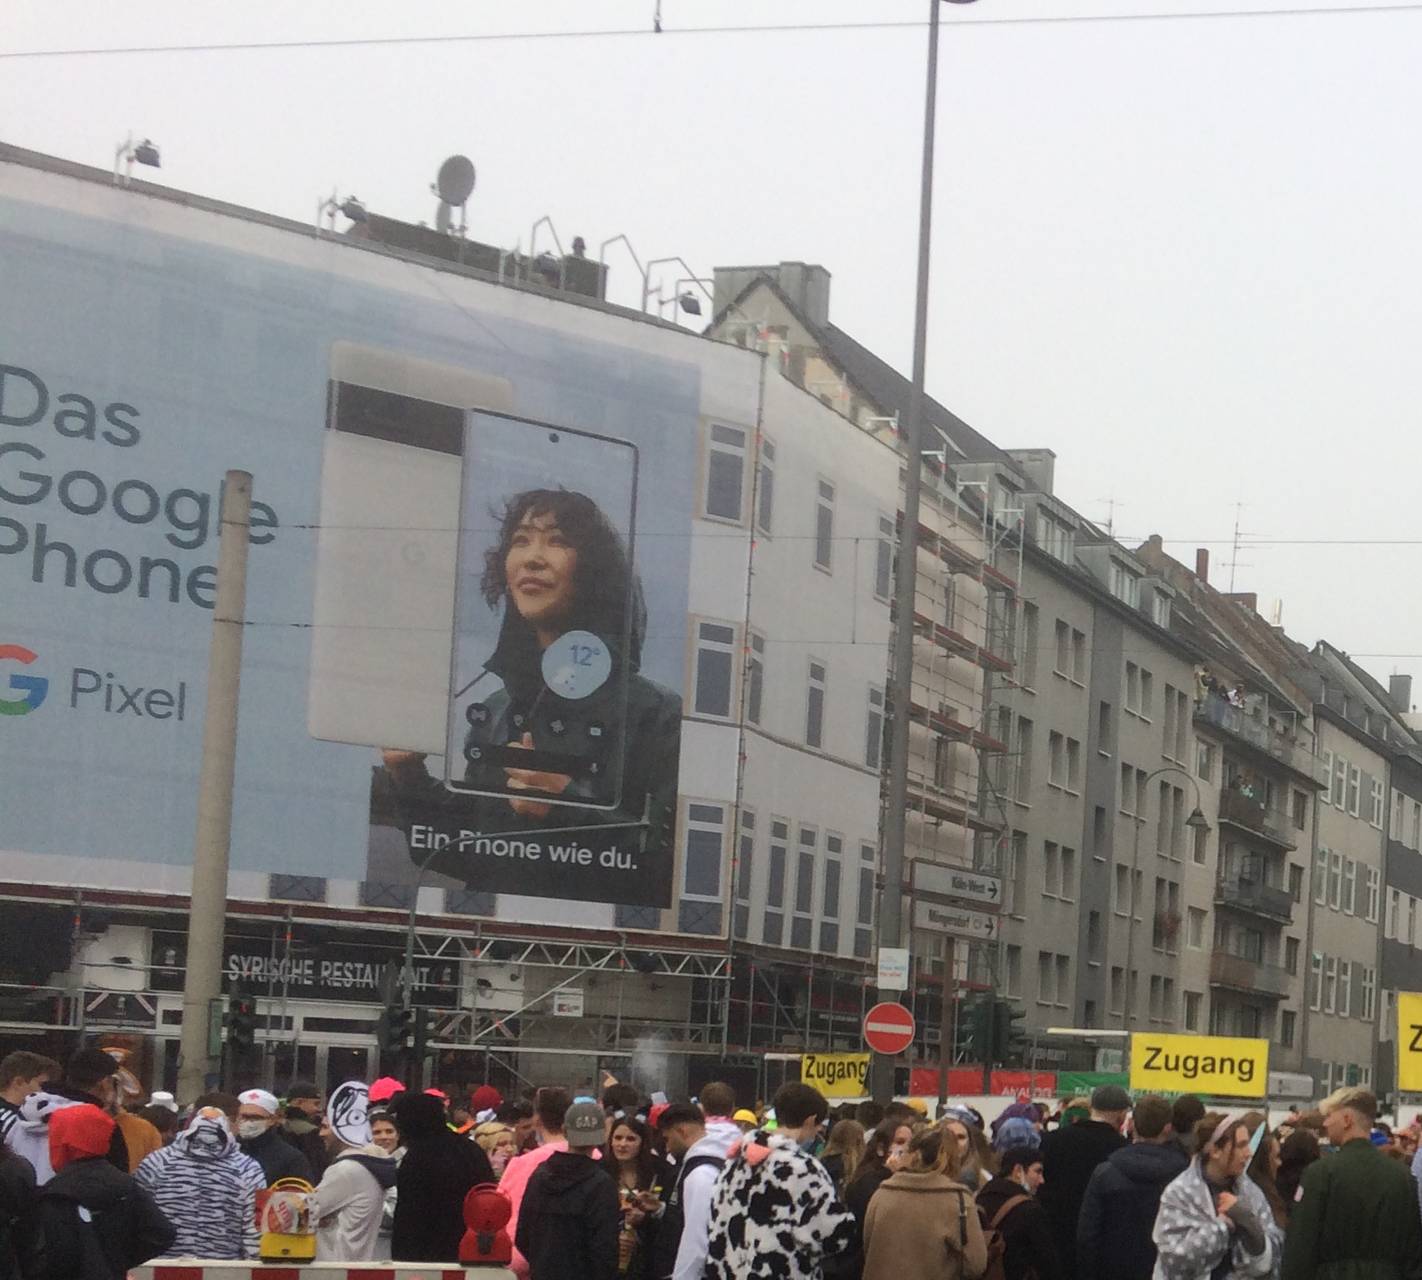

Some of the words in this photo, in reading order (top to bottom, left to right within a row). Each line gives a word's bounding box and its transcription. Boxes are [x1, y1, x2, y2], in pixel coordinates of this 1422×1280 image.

[0, 364, 141, 447] Das
[0, 644, 49, 716] G
[70, 667, 186, 721] Pixel
[410, 824, 450, 850] Ein
[459, 829, 541, 860] Phone
[549, 842, 593, 865] wie
[599, 846, 638, 870] du.
[228, 953, 314, 985] SYRISCHE
[320, 959, 430, 992] RESTAUANT
[804, 1054, 870, 1085] Zugang
[1143, 1046, 1255, 1082] Zugang
[575, 1115, 598, 1129] GAP
